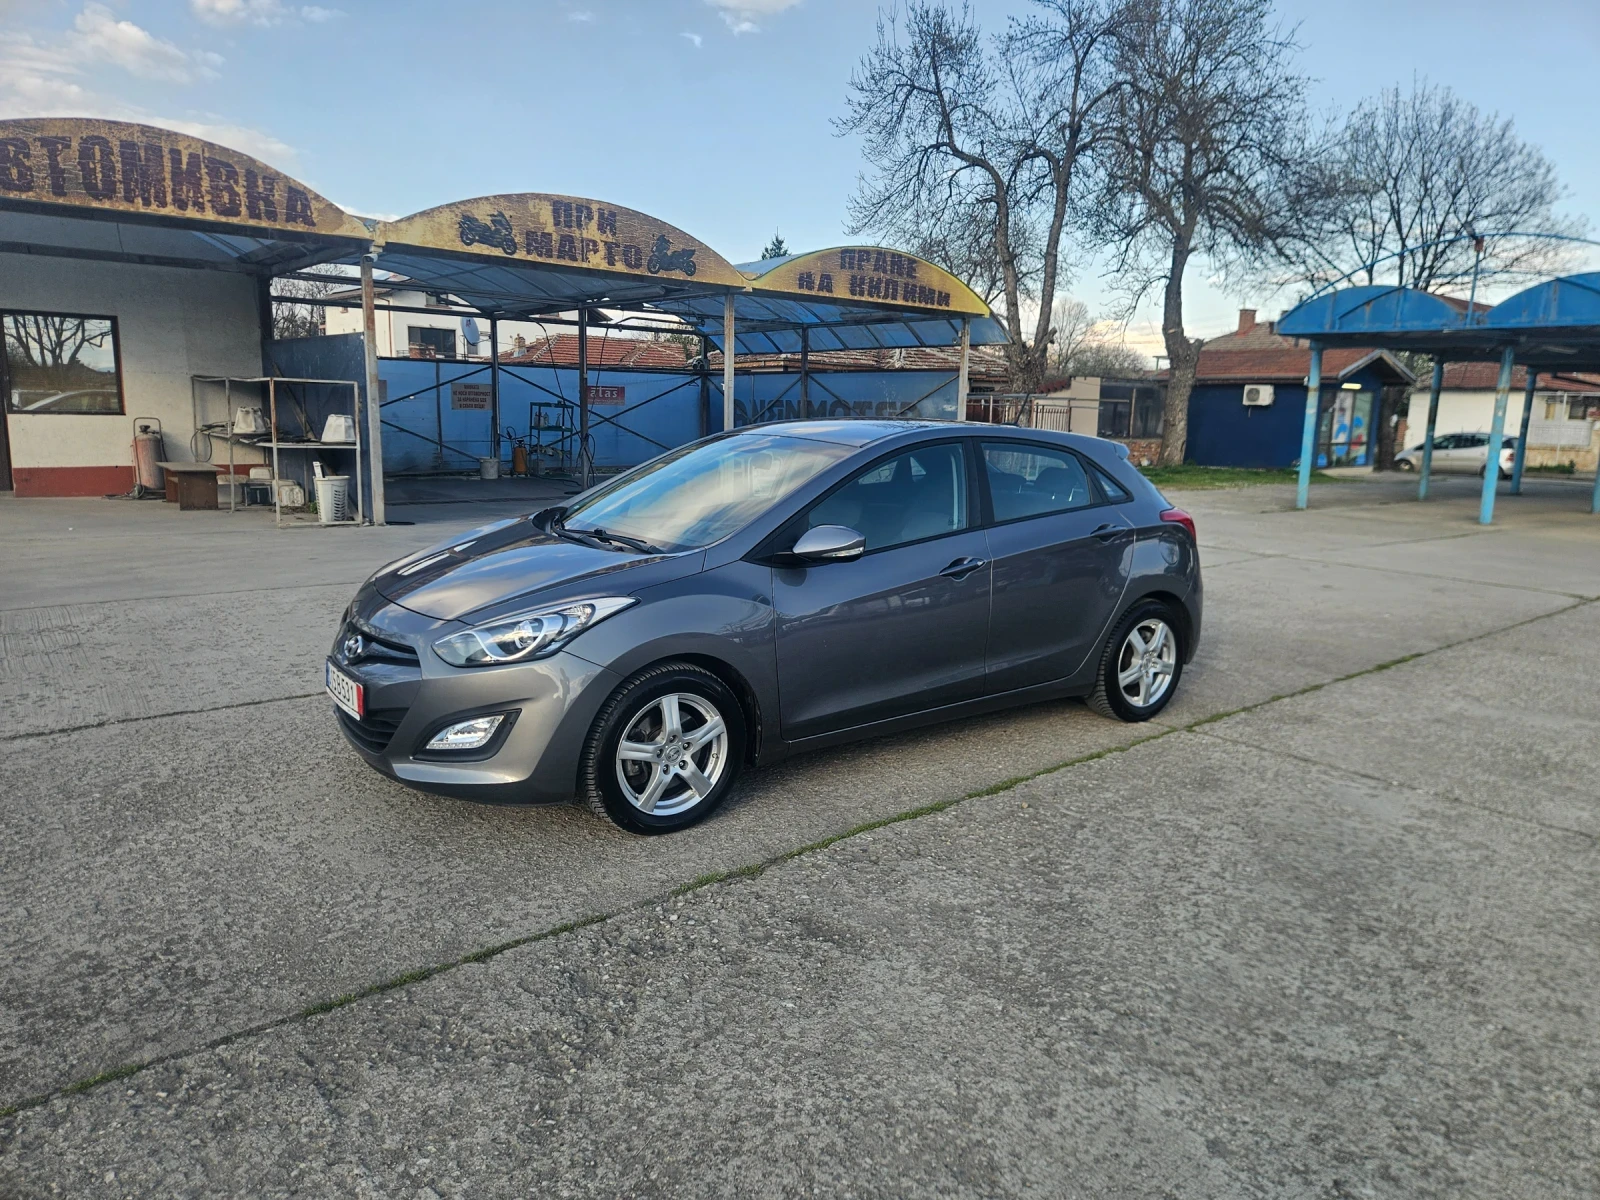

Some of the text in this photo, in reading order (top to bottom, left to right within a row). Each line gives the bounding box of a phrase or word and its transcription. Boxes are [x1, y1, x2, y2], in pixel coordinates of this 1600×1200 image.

[552, 200, 617, 236] ПРИ
[526, 231, 642, 269] МАРТО
[840, 249, 917, 279] ПРАНЕ
[798, 271, 950, 307] НА КИЛИМИ
